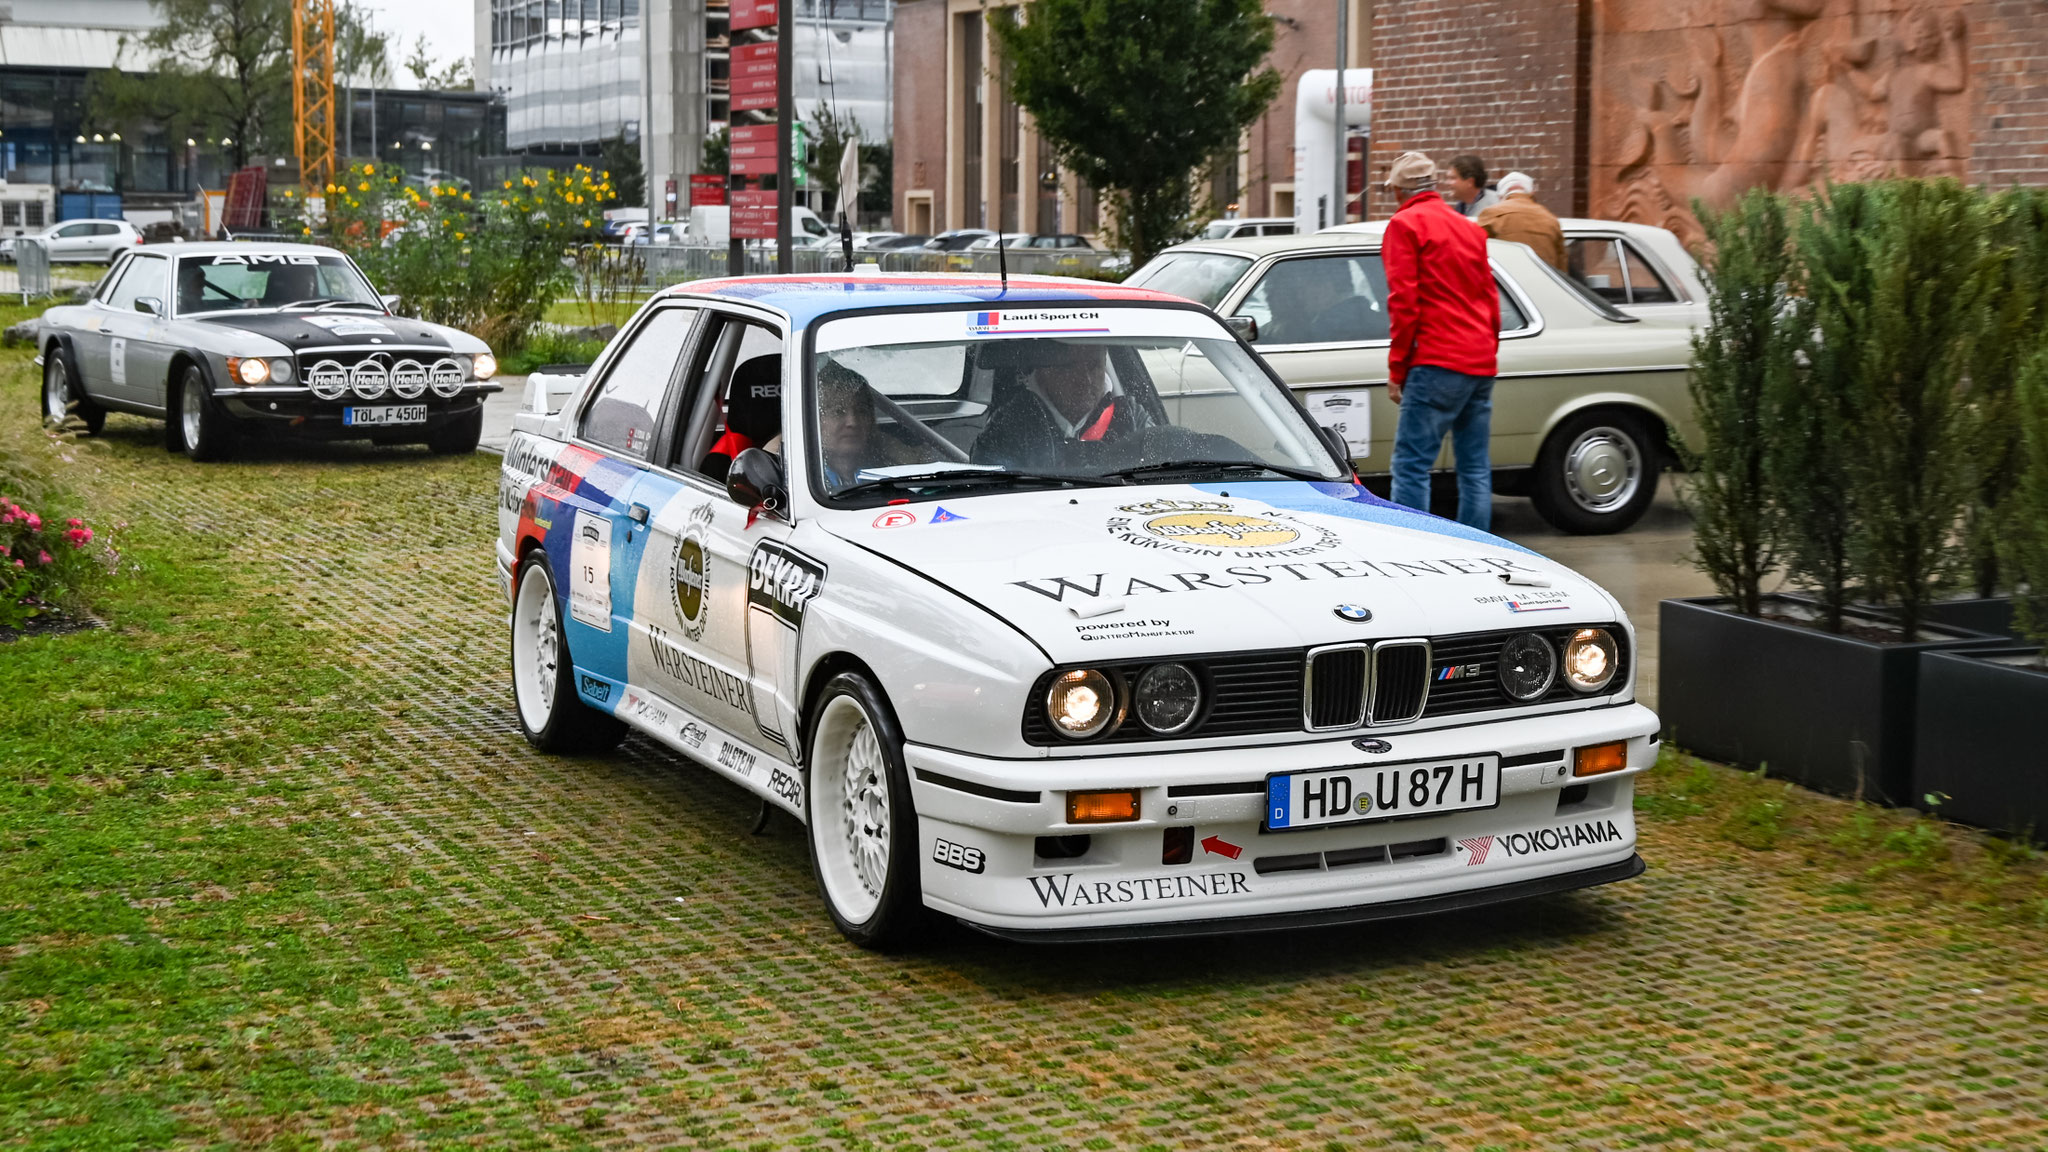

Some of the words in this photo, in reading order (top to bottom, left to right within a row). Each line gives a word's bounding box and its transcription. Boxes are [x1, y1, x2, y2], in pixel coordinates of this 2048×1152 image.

[211, 255, 320, 265] AMG
[1003, 313, 1038, 321] Lauti
[1040, 313, 1077, 321] Sport
[1079, 312, 1099, 320] CH
[315, 375, 344, 386] Hella
[356, 375, 384, 386] Hella
[396, 374, 423, 385] Hella
[434, 374, 461, 384] Hella
[385, 408, 393, 421] F
[396, 407, 426, 421] 450H
[885, 516, 903, 527] E
[1234, 546, 1325, 558] UNTER
[583, 565, 594, 584] 15
[750, 548, 818, 613] DEKRA
[1003, 557, 1544, 602] WARSTEINER
[1076, 619, 1147, 632] powered
[1150, 617, 1171, 628] by
[649, 624, 751, 715] WARSTEINER
[1453, 663, 1481, 679] M3
[583, 677, 610, 702] Sabelt
[716, 740, 757, 777] BILSTEIN
[1275, 807, 1283, 819] D
[1303, 776, 1352, 819] HD
[1376, 770, 1400, 810] U
[1496, 819, 1623, 857] YOKOHAMA
[933, 838, 985, 874] BBS
[1026, 871, 1252, 908] WARSTEINER
